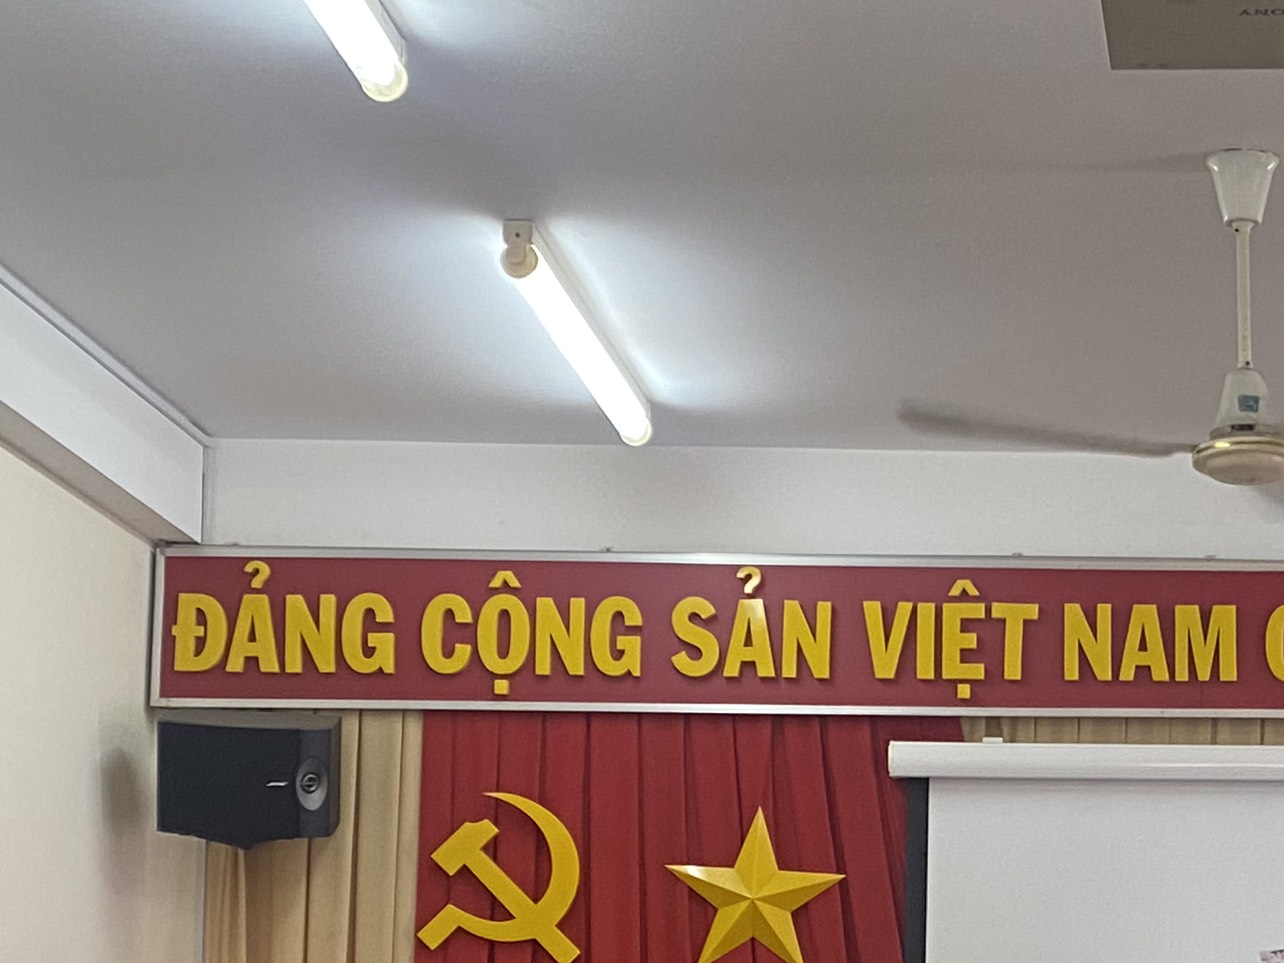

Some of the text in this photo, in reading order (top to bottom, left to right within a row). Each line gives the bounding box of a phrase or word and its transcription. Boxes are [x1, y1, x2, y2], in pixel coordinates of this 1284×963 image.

[171, 560, 396, 675] ĐẢNG
[420, 569, 643, 696] CỘNG
[670, 566, 833, 681] SẢN
[862, 579, 1040, 699] VIỆT
[1062, 603, 1238, 683] NAM
